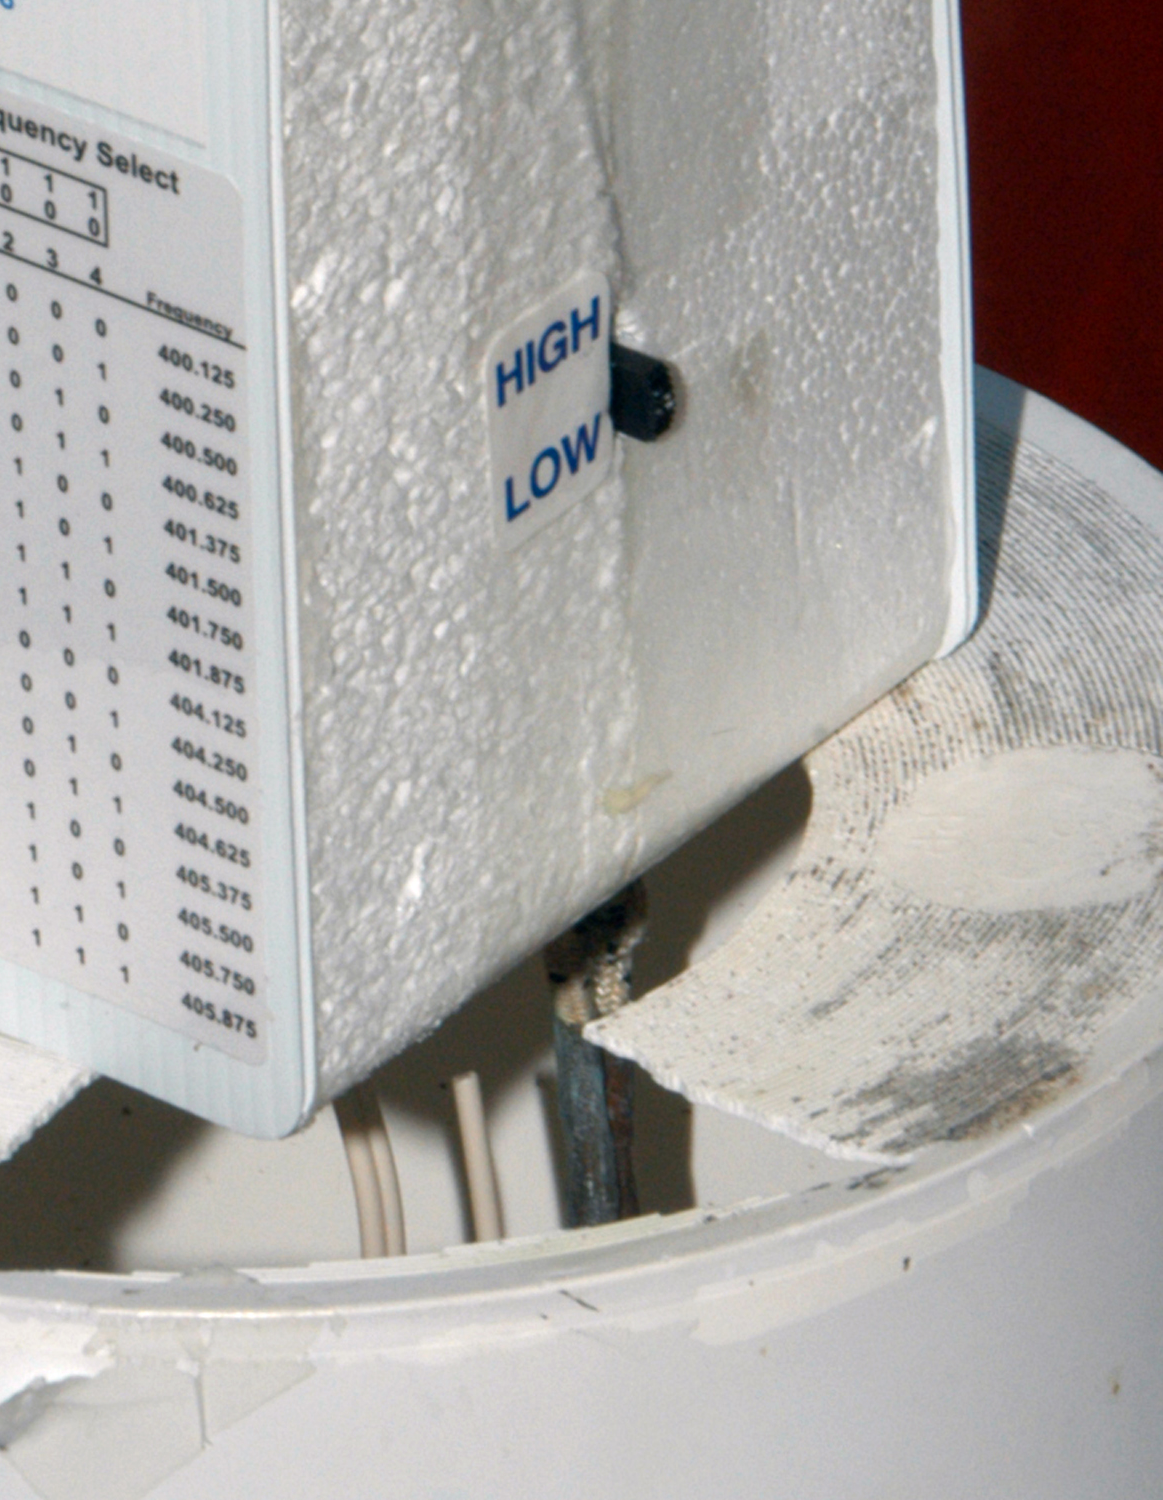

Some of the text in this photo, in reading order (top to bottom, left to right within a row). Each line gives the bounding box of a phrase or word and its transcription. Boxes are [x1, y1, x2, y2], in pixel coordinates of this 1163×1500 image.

[0, 156, 11, 177] 1
[43, 173, 54, 193] 1
[87, 189, 98, 210] 1
[96, 141, 180, 195] Select
[2, 230, 15, 252] 2
[46, 247, 59, 269] 3
[89, 266, 104, 286] 4
[145, 290, 234, 341] Frequency
[97, 362, 106, 381] 1
[159, 388, 236, 433] 400.250
[157, 344, 235, 389] 400.125
[495, 295, 600, 408] HIGH
[55, 388, 64, 407] 1
[160, 431, 238, 477] 400.500
[56, 431, 65, 450] 1
[100, 449, 109, 467] 1
[161, 475, 240, 520] 400.625
[504, 411, 601, 523] LOW
[14, 457, 22, 475] 1
[163, 518, 241, 564] 401.375
[15, 500, 24, 518] 1
[103, 536, 113, 554] 1
[165, 562, 242, 608] 401.500
[17, 543, 25, 562] 1
[61, 561, 70, 580] 1
[166, 605, 244, 651] 401.750
[18, 587, 27, 605] 1
[62, 605, 71, 623] 1
[107, 623, 116, 641] 1
[168, 649, 246, 695] 401.875
[110, 710, 119, 728] 1
[171, 736, 248, 782] 404.250
[169, 693, 247, 739] 404.125
[67, 735, 76, 753] 1
[172, 779, 249, 825] 404.500
[69, 777, 78, 796] 1
[113, 796, 122, 814] 1
[174, 822, 251, 868] 404.625
[27, 802, 35, 819] 1
[176, 865, 252, 911] 405.375
[29, 844, 37, 862] 1
[116, 881, 125, 899] 1
[177, 907, 254, 953] 405.500
[30, 886, 39, 904] 1
[75, 905, 83, 923] 1
[179, 950, 256, 996] 405.750
[32, 928, 41, 946] 1
[76, 947, 85, 965] 1
[120, 965, 129, 983] 1
[181, 992, 257, 1039] 405.875
